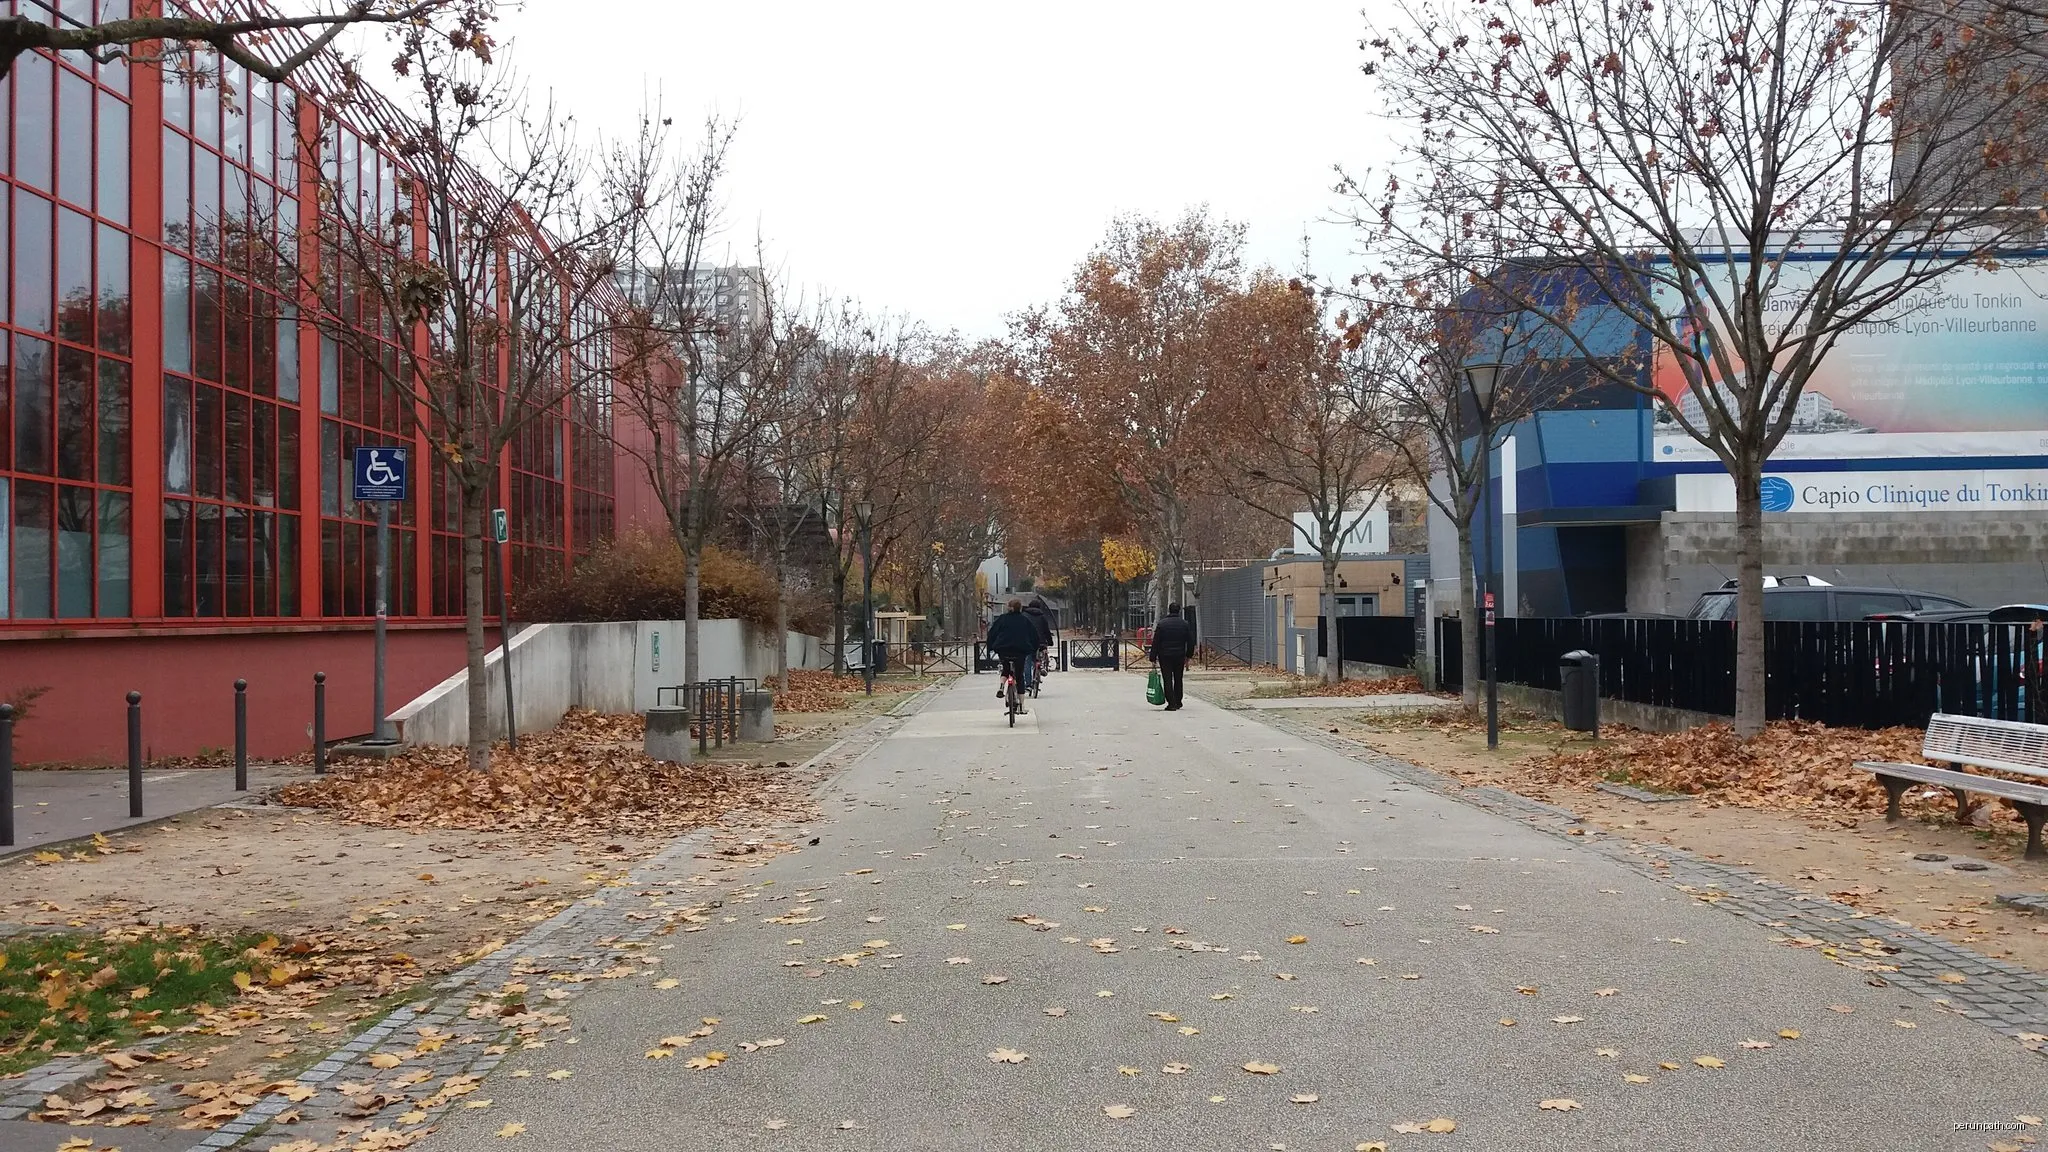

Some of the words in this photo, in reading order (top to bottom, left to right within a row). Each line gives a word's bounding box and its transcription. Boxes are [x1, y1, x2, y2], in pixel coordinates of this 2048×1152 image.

[1763, 295, 1816, 312] Janvir
[1951, 293, 1968, 309] du
[1973, 293, 2022, 309] Tonkin
[1906, 317, 2037, 337] Lyon-Villeurbanne
[1802, 485, 1860, 509] Capio
[1866, 483, 1950, 508] Clinique
[1956, 483, 1980, 502] du
[1310, 520, 1373, 546] IM
